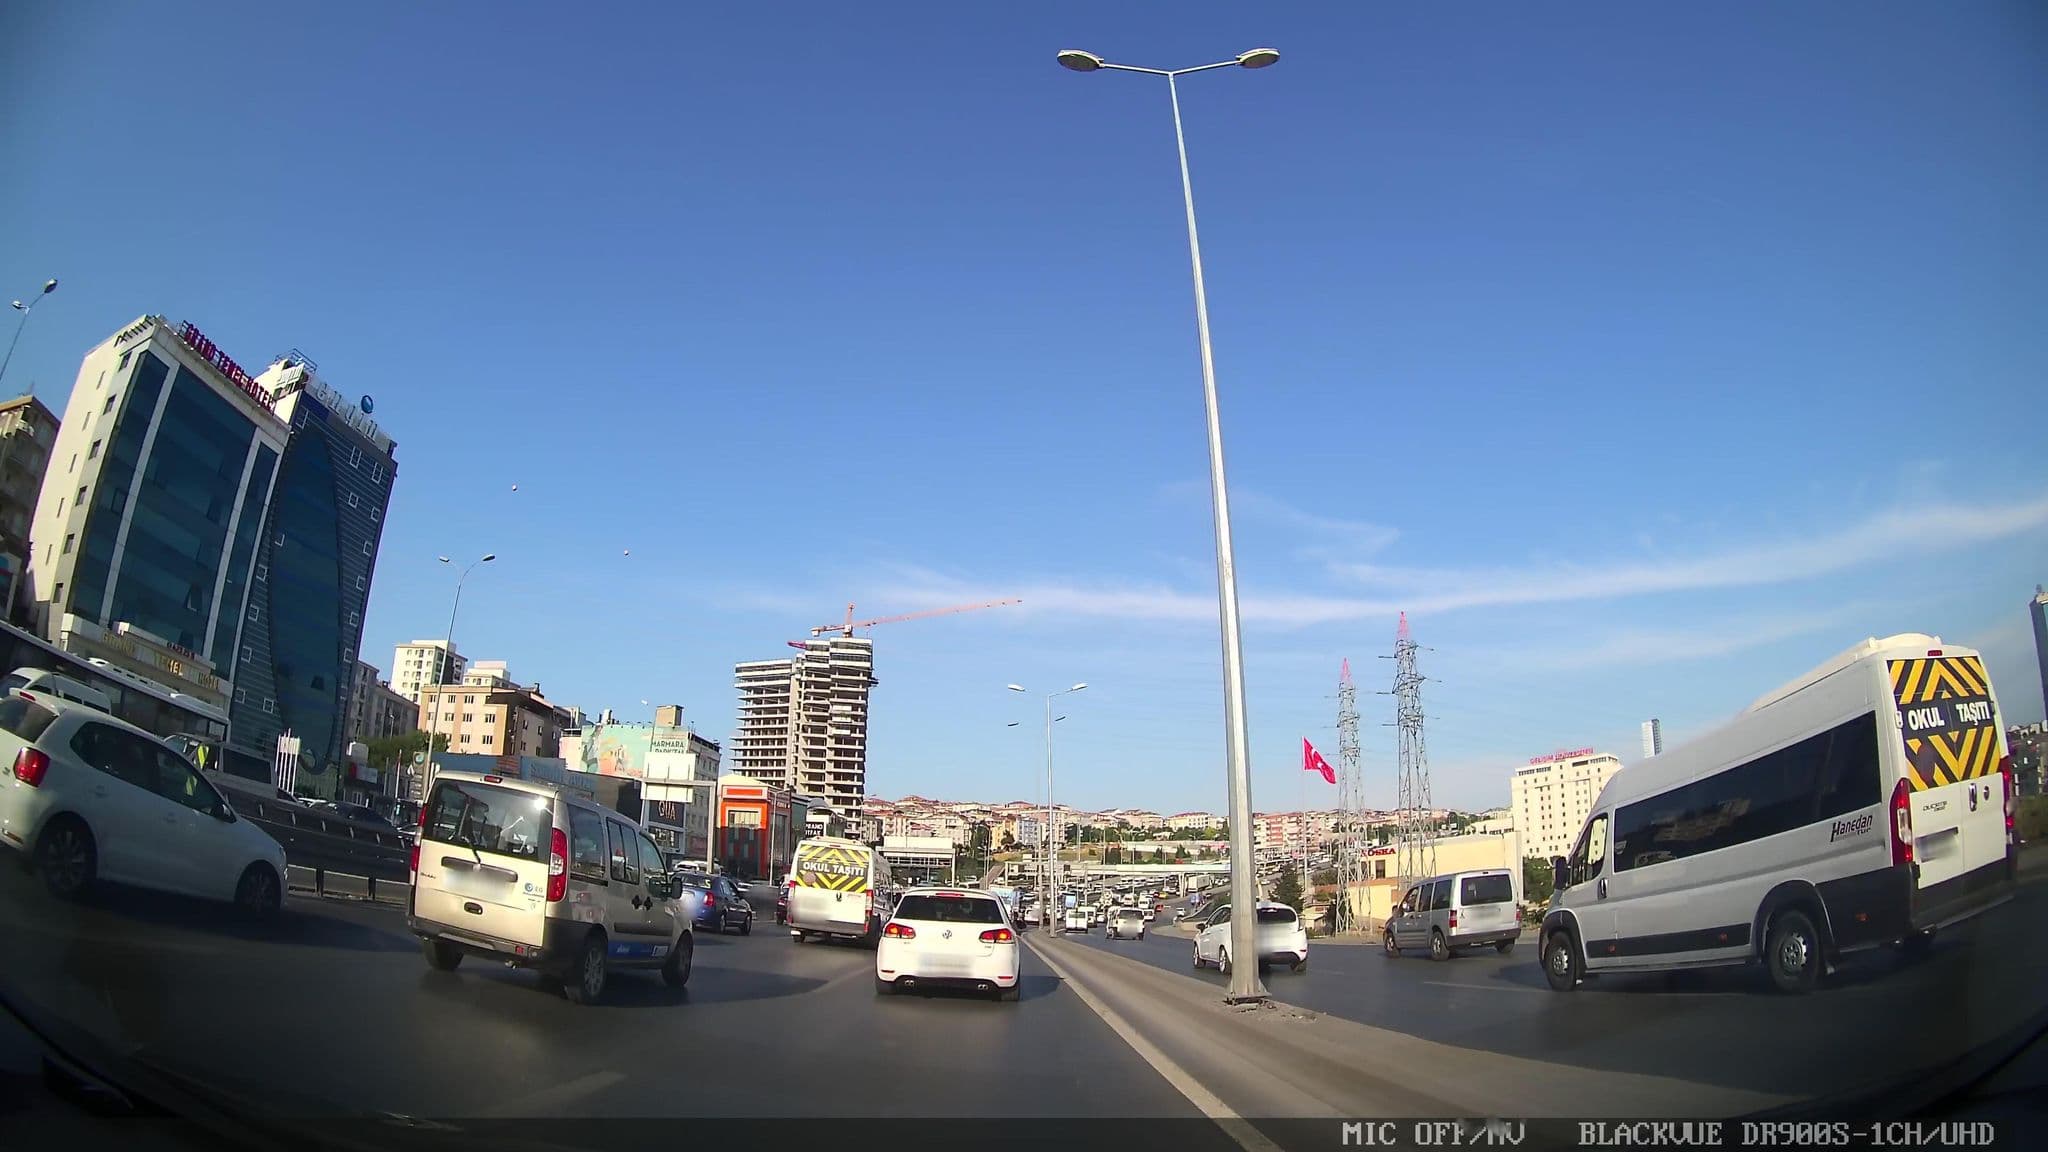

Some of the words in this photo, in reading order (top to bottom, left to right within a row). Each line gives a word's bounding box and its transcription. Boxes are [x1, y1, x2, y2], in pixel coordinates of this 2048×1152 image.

[185, 323, 217, 362] GRAND
[218, 351, 246, 388] TEMEL
[246, 376, 275, 416] HOTEL
[1908, 708, 1945, 730] OKUL
[1830, 814, 1873, 843] Hanedan
[803, 861, 831, 873] OKUL
